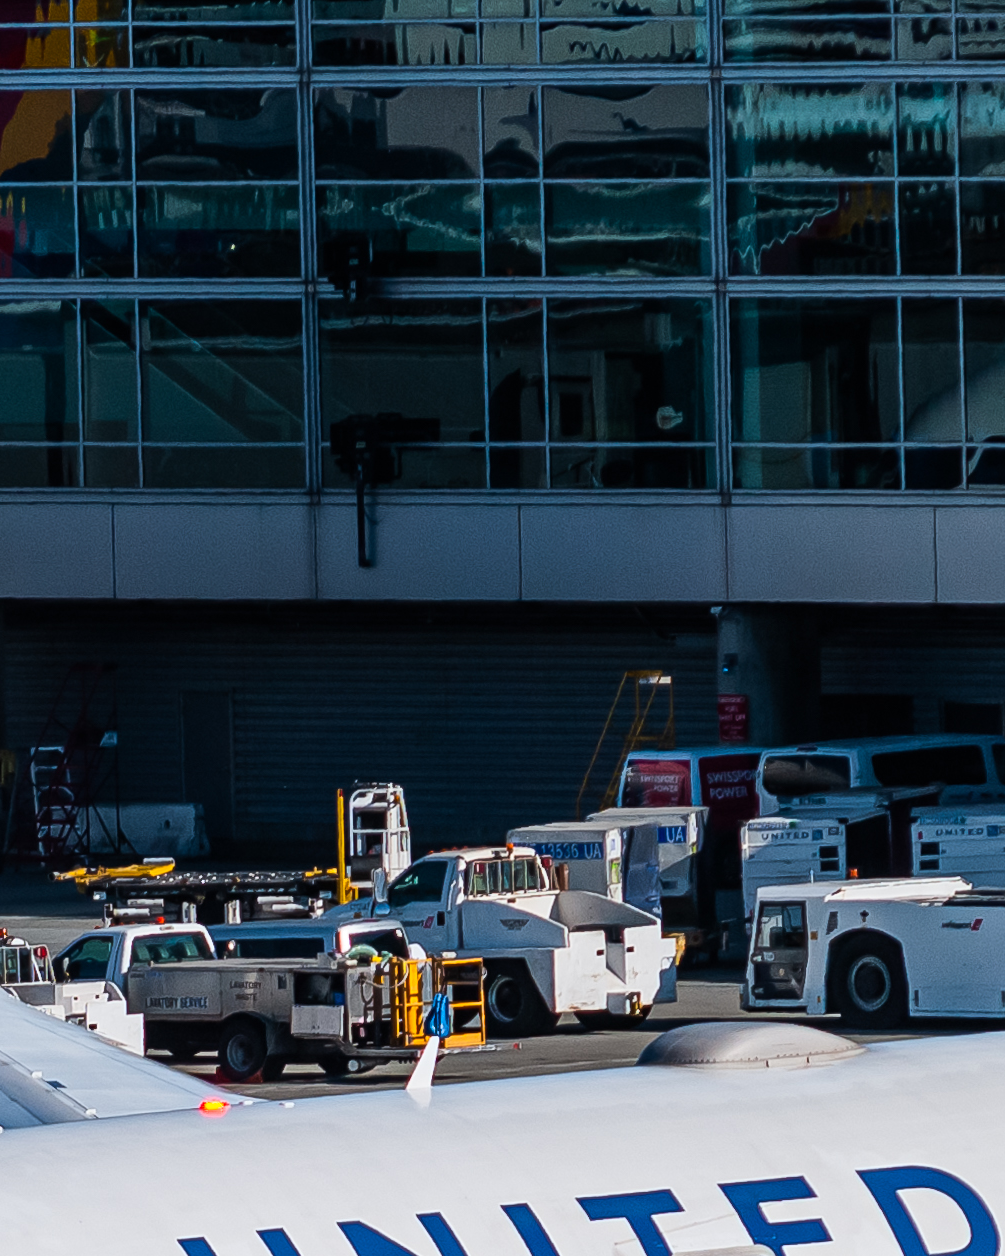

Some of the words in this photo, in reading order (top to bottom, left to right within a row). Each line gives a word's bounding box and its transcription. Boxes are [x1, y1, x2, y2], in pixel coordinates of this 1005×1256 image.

[709, 786, 748, 799] POWER
[665, 826, 684, 842] UA
[761, 831, 810, 841] UNITED
[935, 827, 984, 837] UNITED
[583, 843, 602, 860] UA
